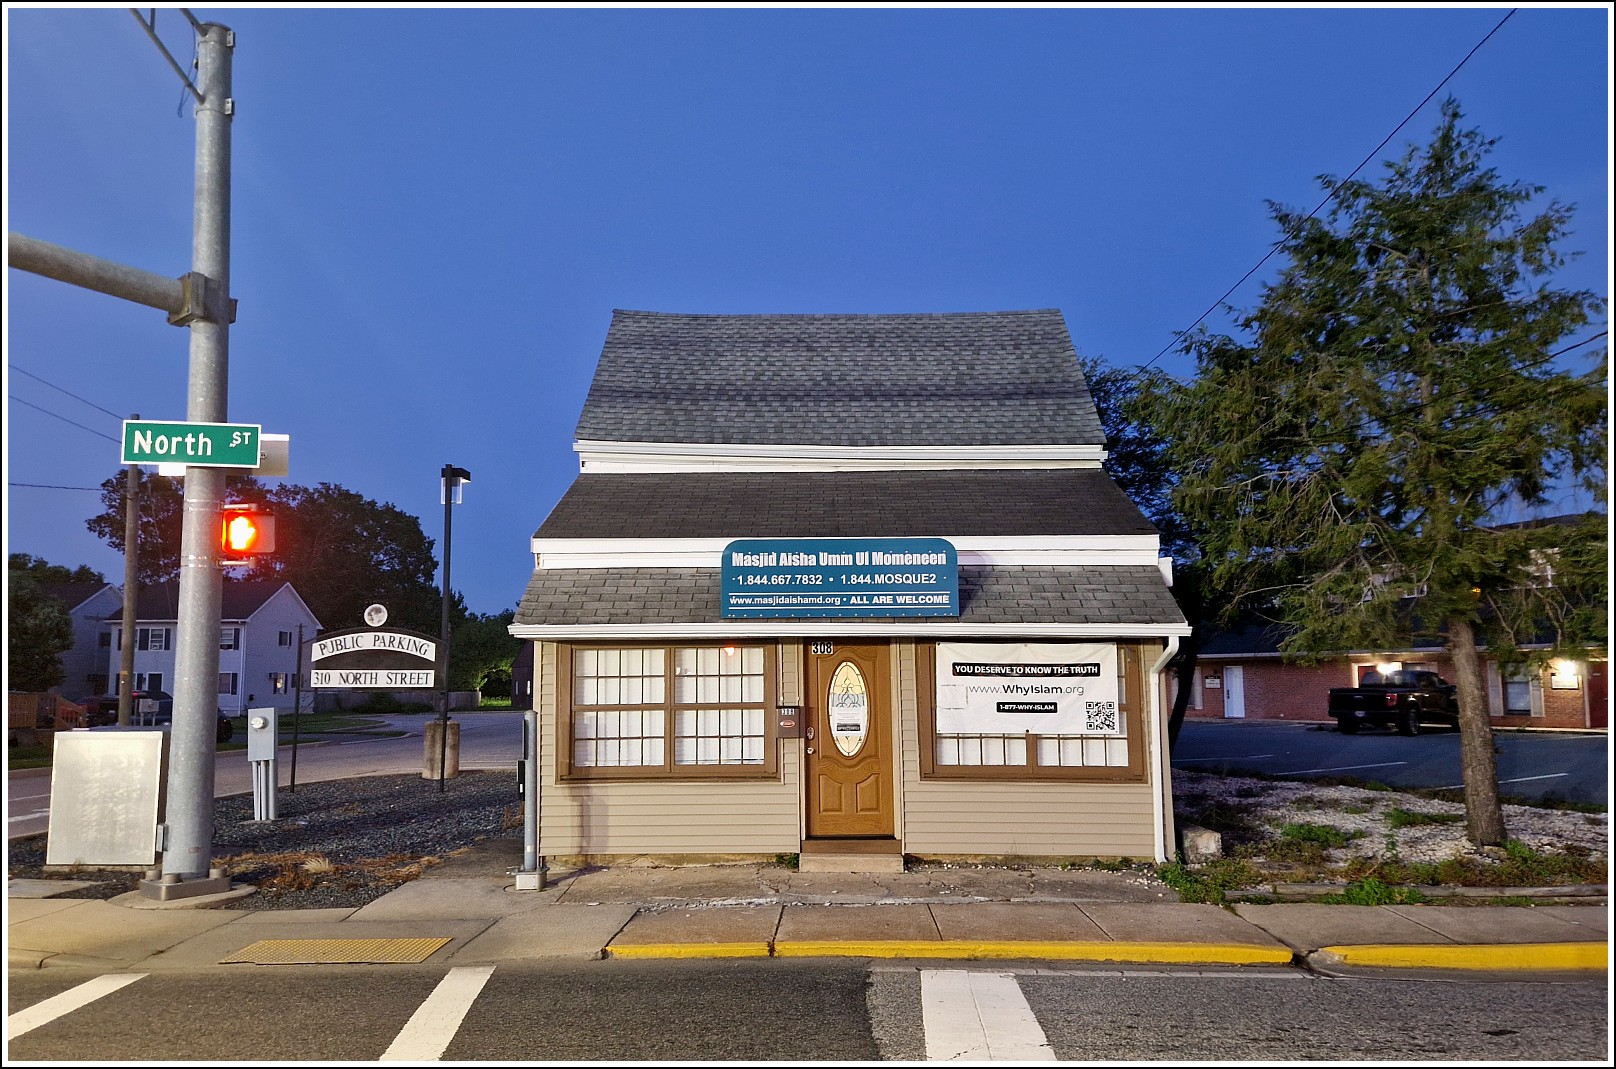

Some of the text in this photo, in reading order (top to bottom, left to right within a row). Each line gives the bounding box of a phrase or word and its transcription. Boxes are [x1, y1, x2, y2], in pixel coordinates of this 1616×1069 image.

[133, 430, 252, 456] North ST
[731, 551, 947, 567] Masjid Aisha Umm Ul Momeneen
[737, 573, 937, 585] 1.844.667.7832 1.844.MOSQUE2
[729, 595, 950, 606] www.masjidaishamd.org ALL ARE WELCOME
[318, 634, 430, 656] PUBLIC PARKING
[812, 642, 832, 654] 308
[954, 665, 1098, 674] YOU DESERVE TO KNOW THE TRUTH
[313, 671, 431, 685] 310 NORTH STREET
[968, 684, 1085, 696] www.WhyIslam.org
